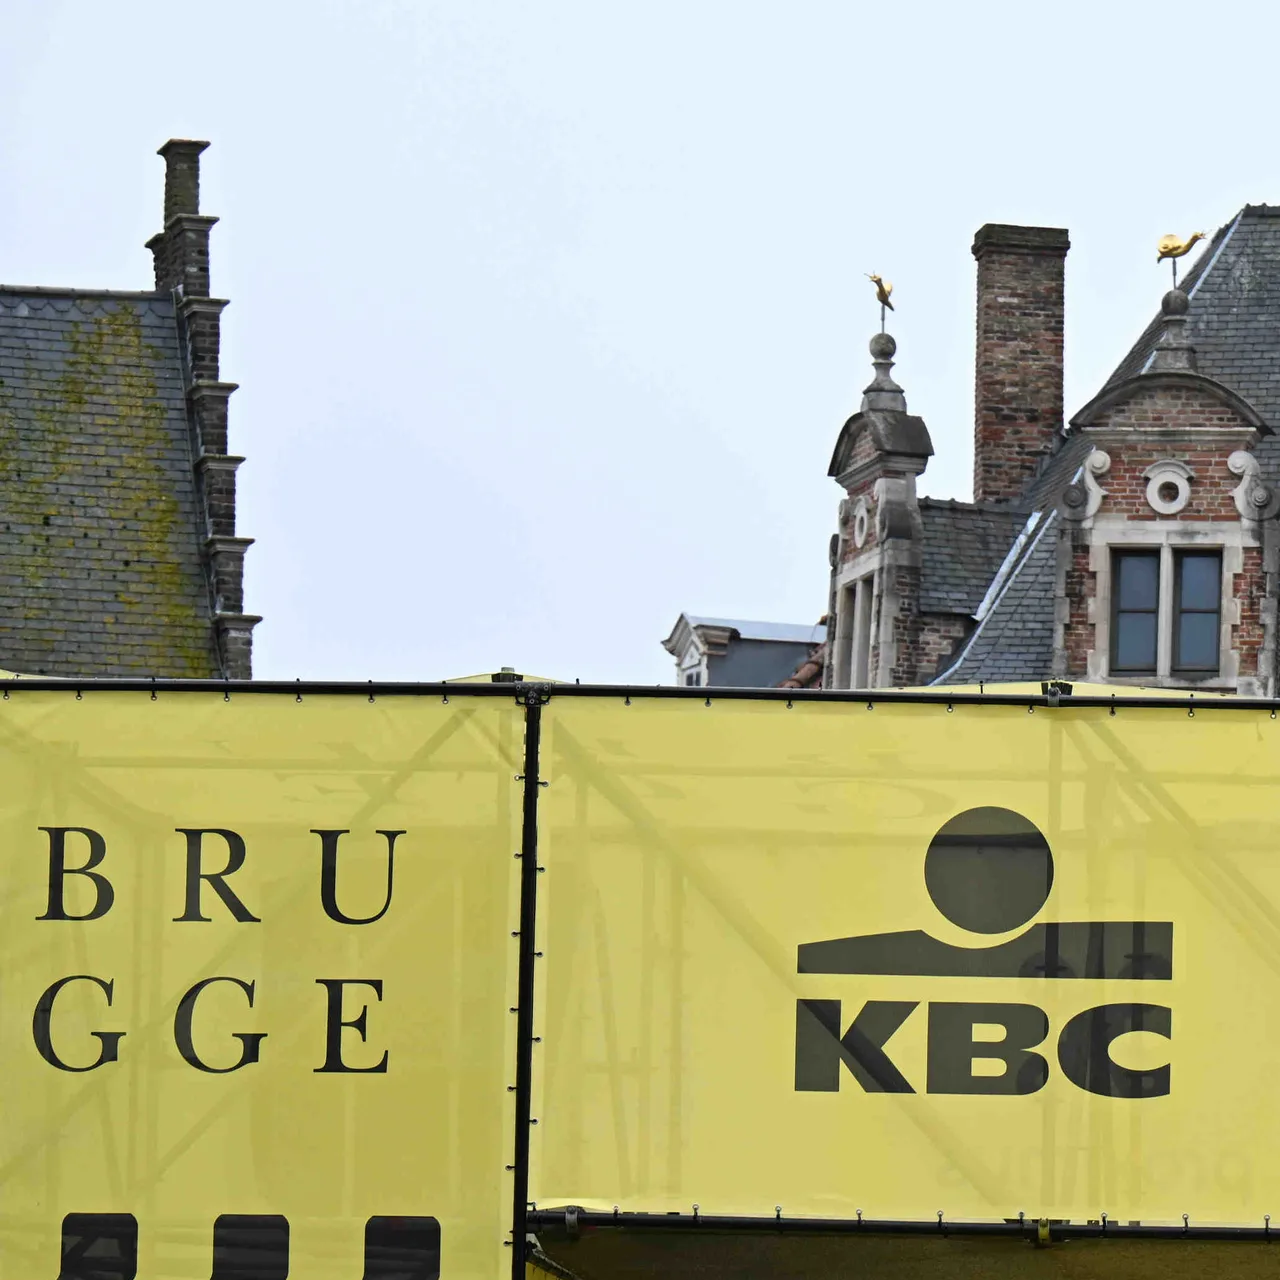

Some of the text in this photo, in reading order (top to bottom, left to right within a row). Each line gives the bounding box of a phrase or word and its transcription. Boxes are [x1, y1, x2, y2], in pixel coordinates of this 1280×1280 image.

[35, 827, 406, 924] BRU
[32, 976, 390, 1074] GGE
[794, 998, 1172, 1098] KBC
